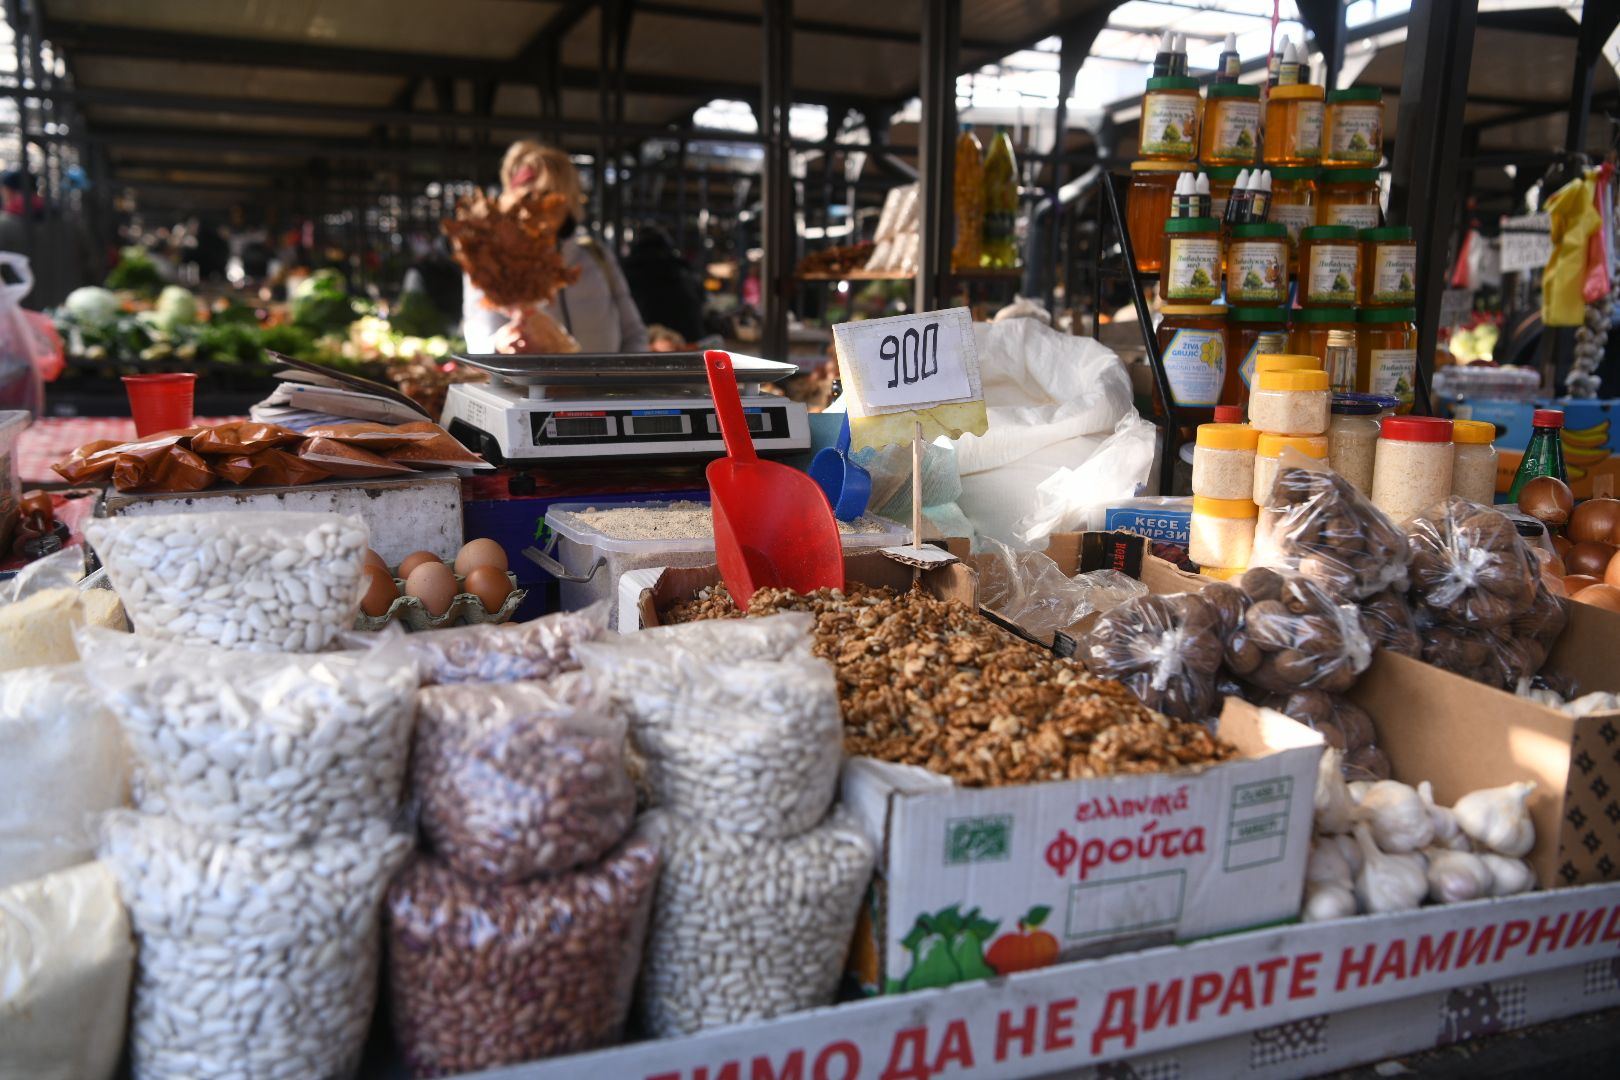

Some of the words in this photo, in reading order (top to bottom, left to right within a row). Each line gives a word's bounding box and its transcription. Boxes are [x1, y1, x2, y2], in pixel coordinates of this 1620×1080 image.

[880, 322, 939, 388] 900
[1135, 516, 1179, 530] КЕСЕ
[879, 1018, 974, 1080] ДА
[994, 998, 1079, 1062] НЕ
[1090, 952, 1324, 1056] ДИРАТЕ
